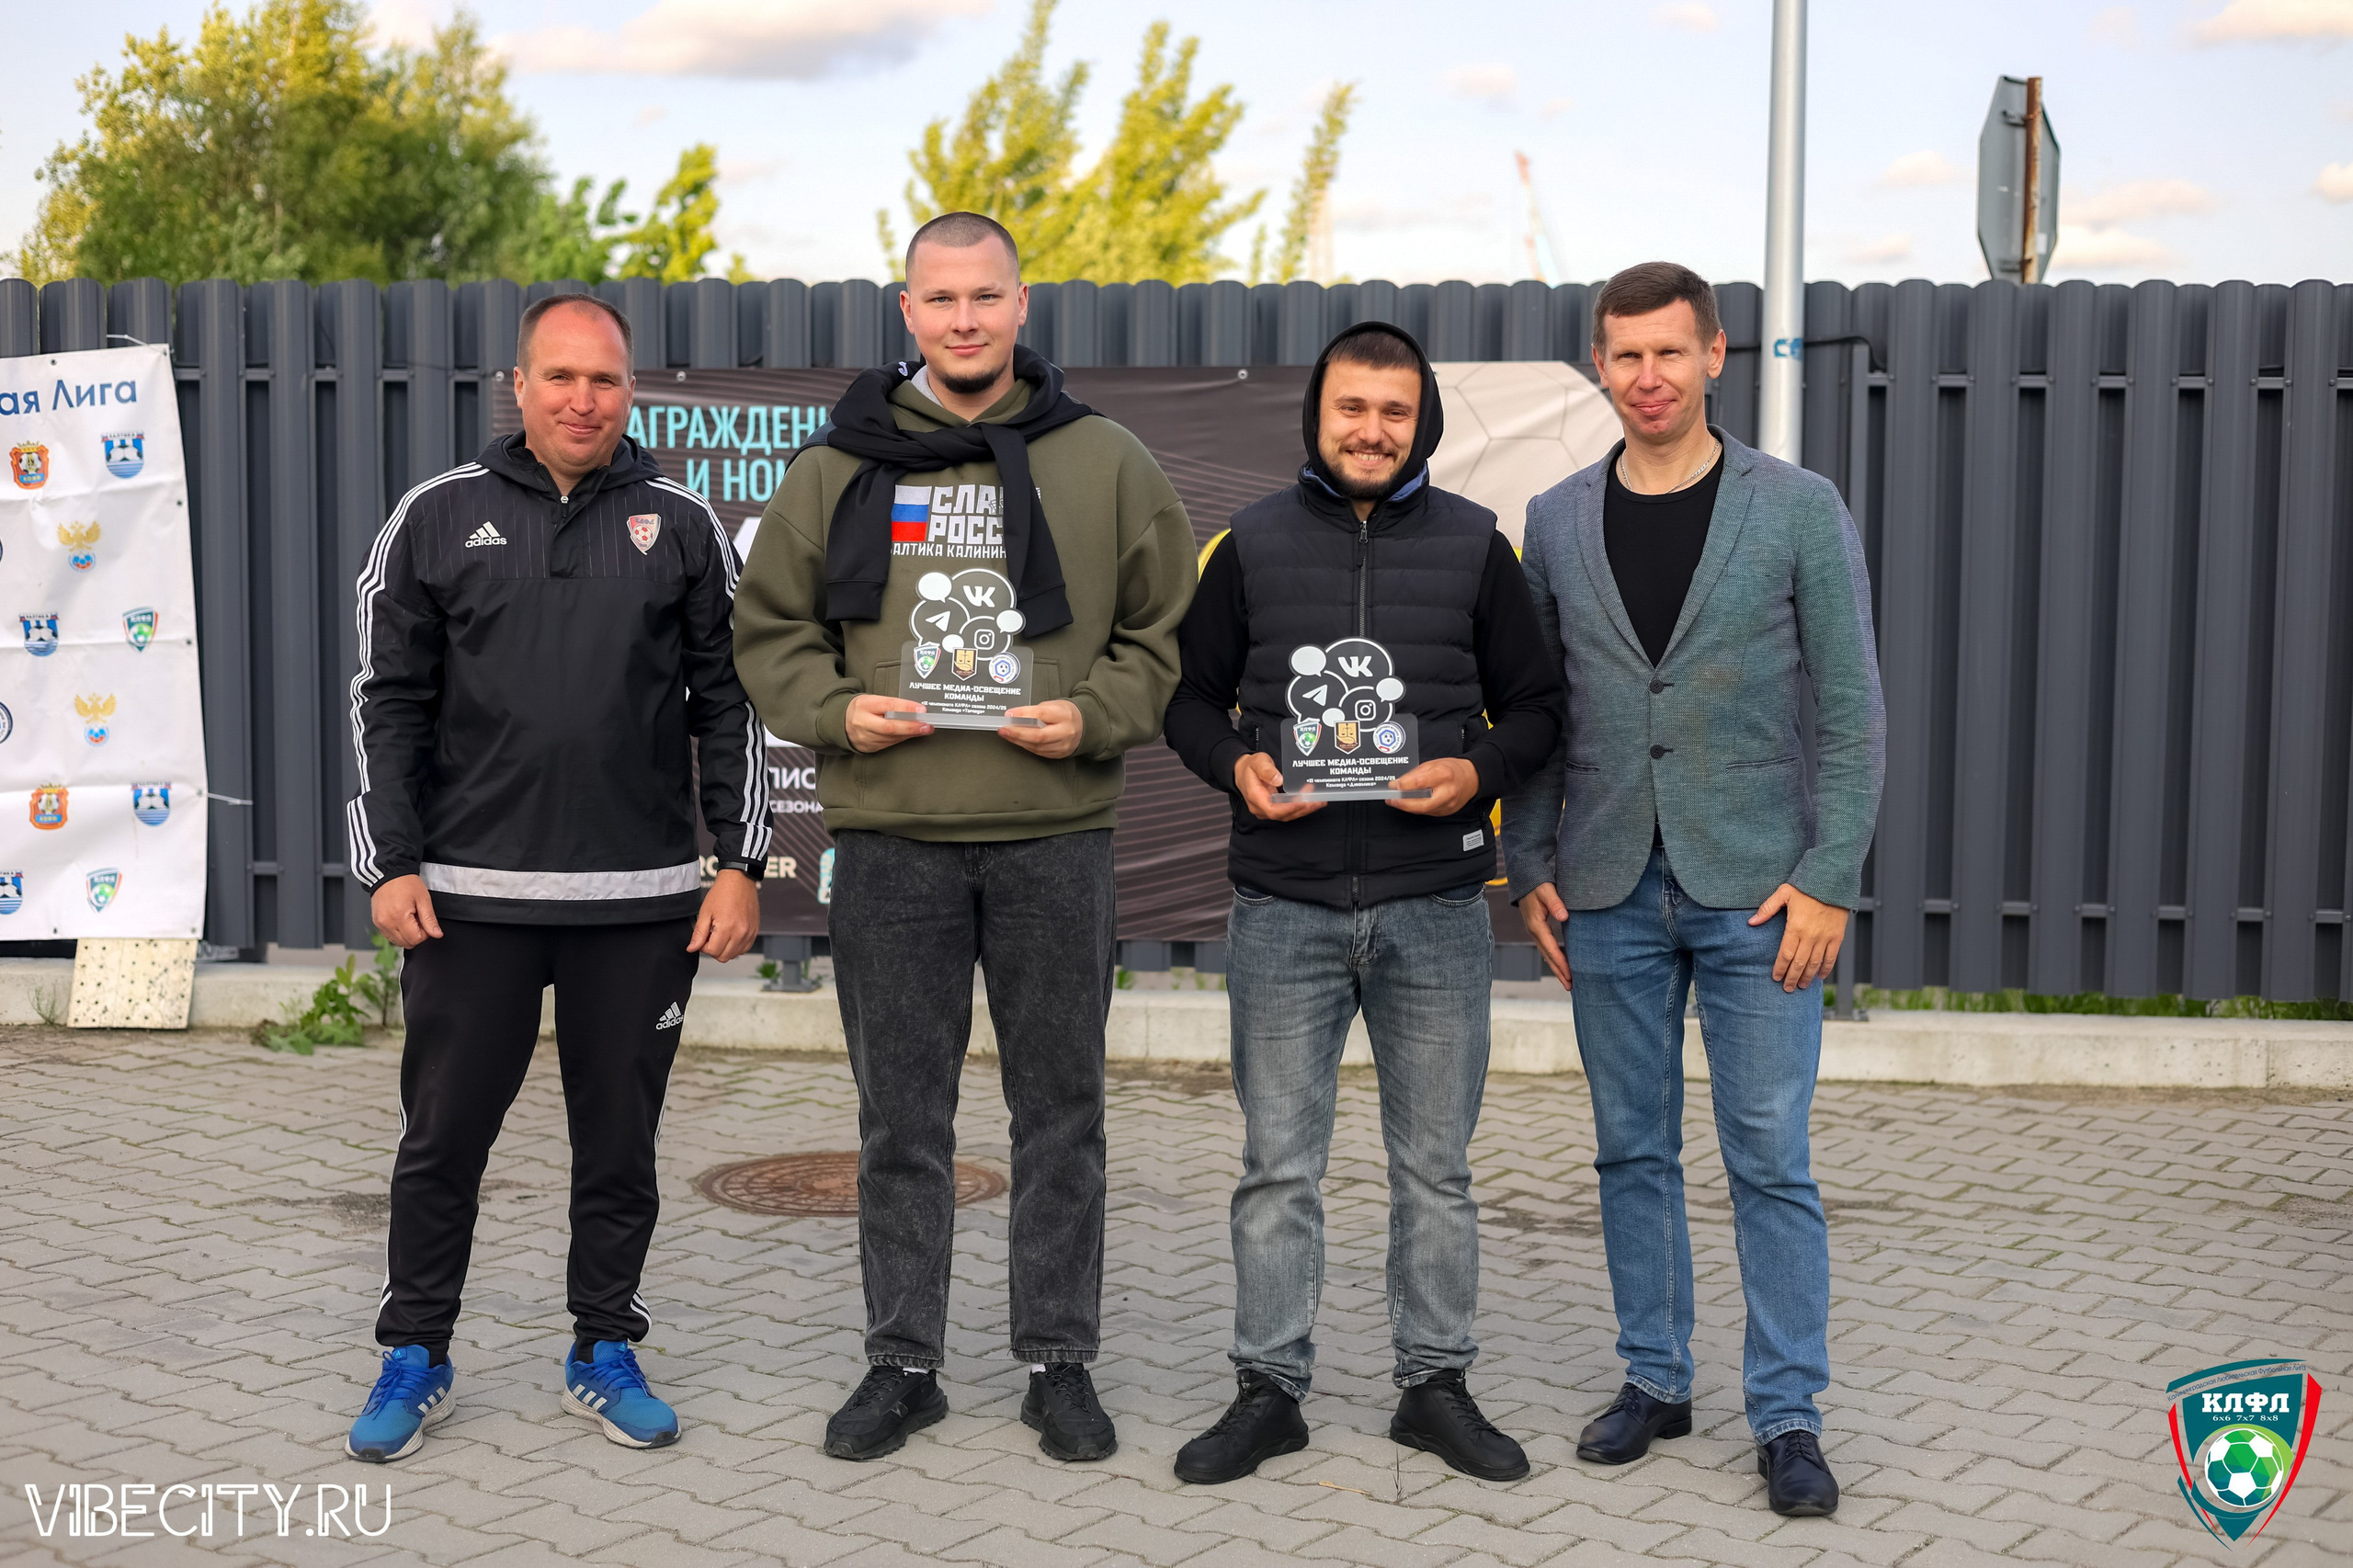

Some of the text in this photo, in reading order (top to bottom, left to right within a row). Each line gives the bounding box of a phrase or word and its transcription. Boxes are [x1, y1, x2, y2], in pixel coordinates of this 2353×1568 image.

[0, 379, 137, 415] ая Лига
[626, 405, 827, 456] АГРАЖДЕН
[722, 458, 788, 503] НО
[931, 483, 1004, 515] СЛА
[927, 515, 1004, 545] РОСС
[465, 536, 507, 548] adidas
[891, 542, 1007, 559] АЛТИКА КАЛИНИН
[963, 585, 995, 608] VK
[1337, 655, 1373, 677] VK
[909, 682, 1021, 696] ЛУЧШЕЕ МЕДИА-ОСВЕЩЕНИЕ
[944, 692, 984, 702] КОМАНДЫ
[1292, 756, 1409, 767] ЛУЧШЕЕ МЕДИА-ОСВЕЩЕНИЕ
[1329, 767, 1372, 776] КОМАНДЫ
